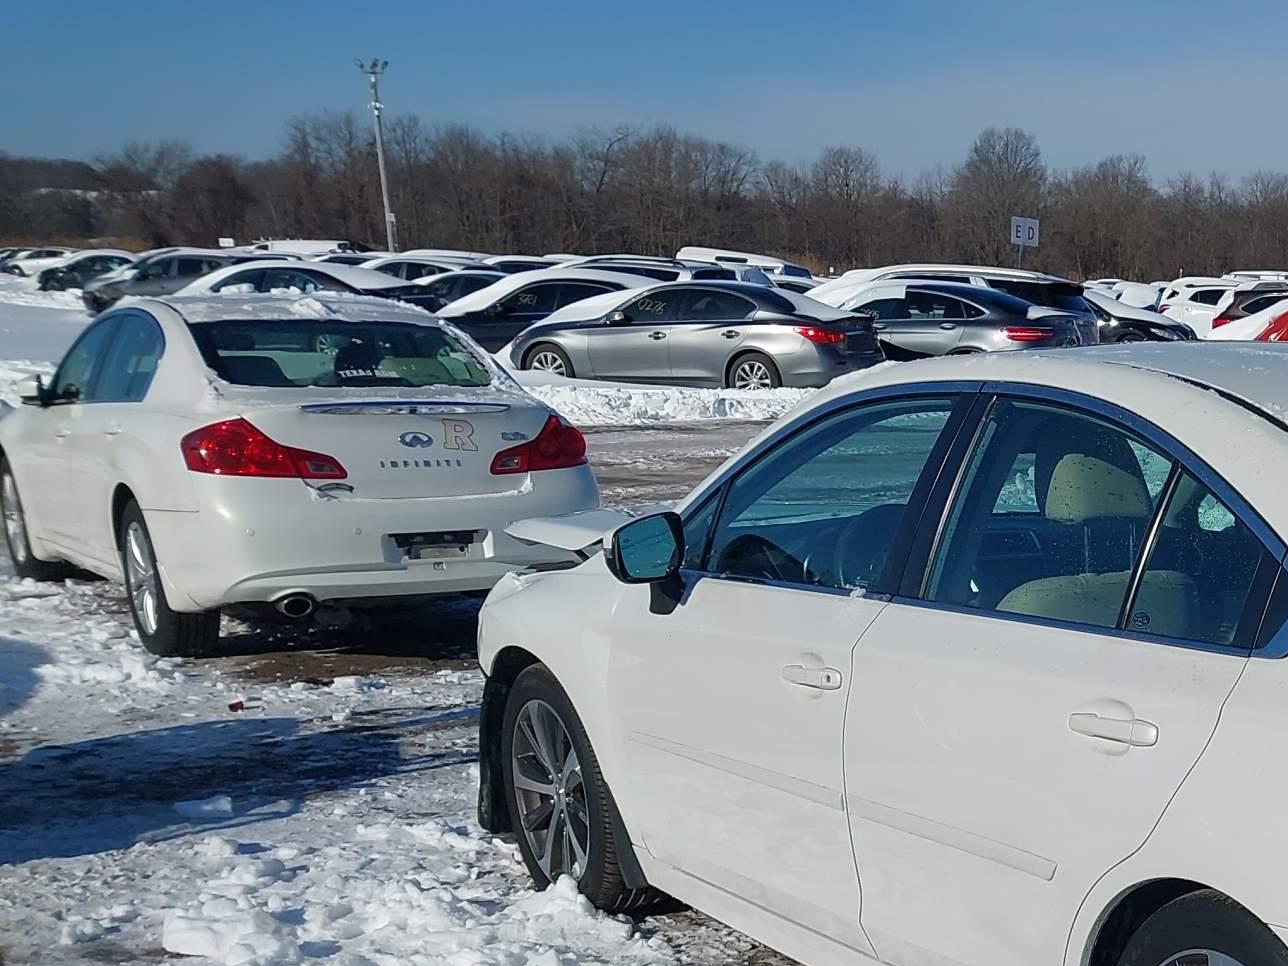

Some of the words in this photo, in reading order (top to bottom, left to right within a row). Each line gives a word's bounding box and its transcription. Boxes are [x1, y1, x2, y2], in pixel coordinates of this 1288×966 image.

[1015, 224, 1022, 239] E
[1027, 226, 1035, 240] D
[441, 417, 479, 452] R
[380, 458, 463, 469] INFINITI
